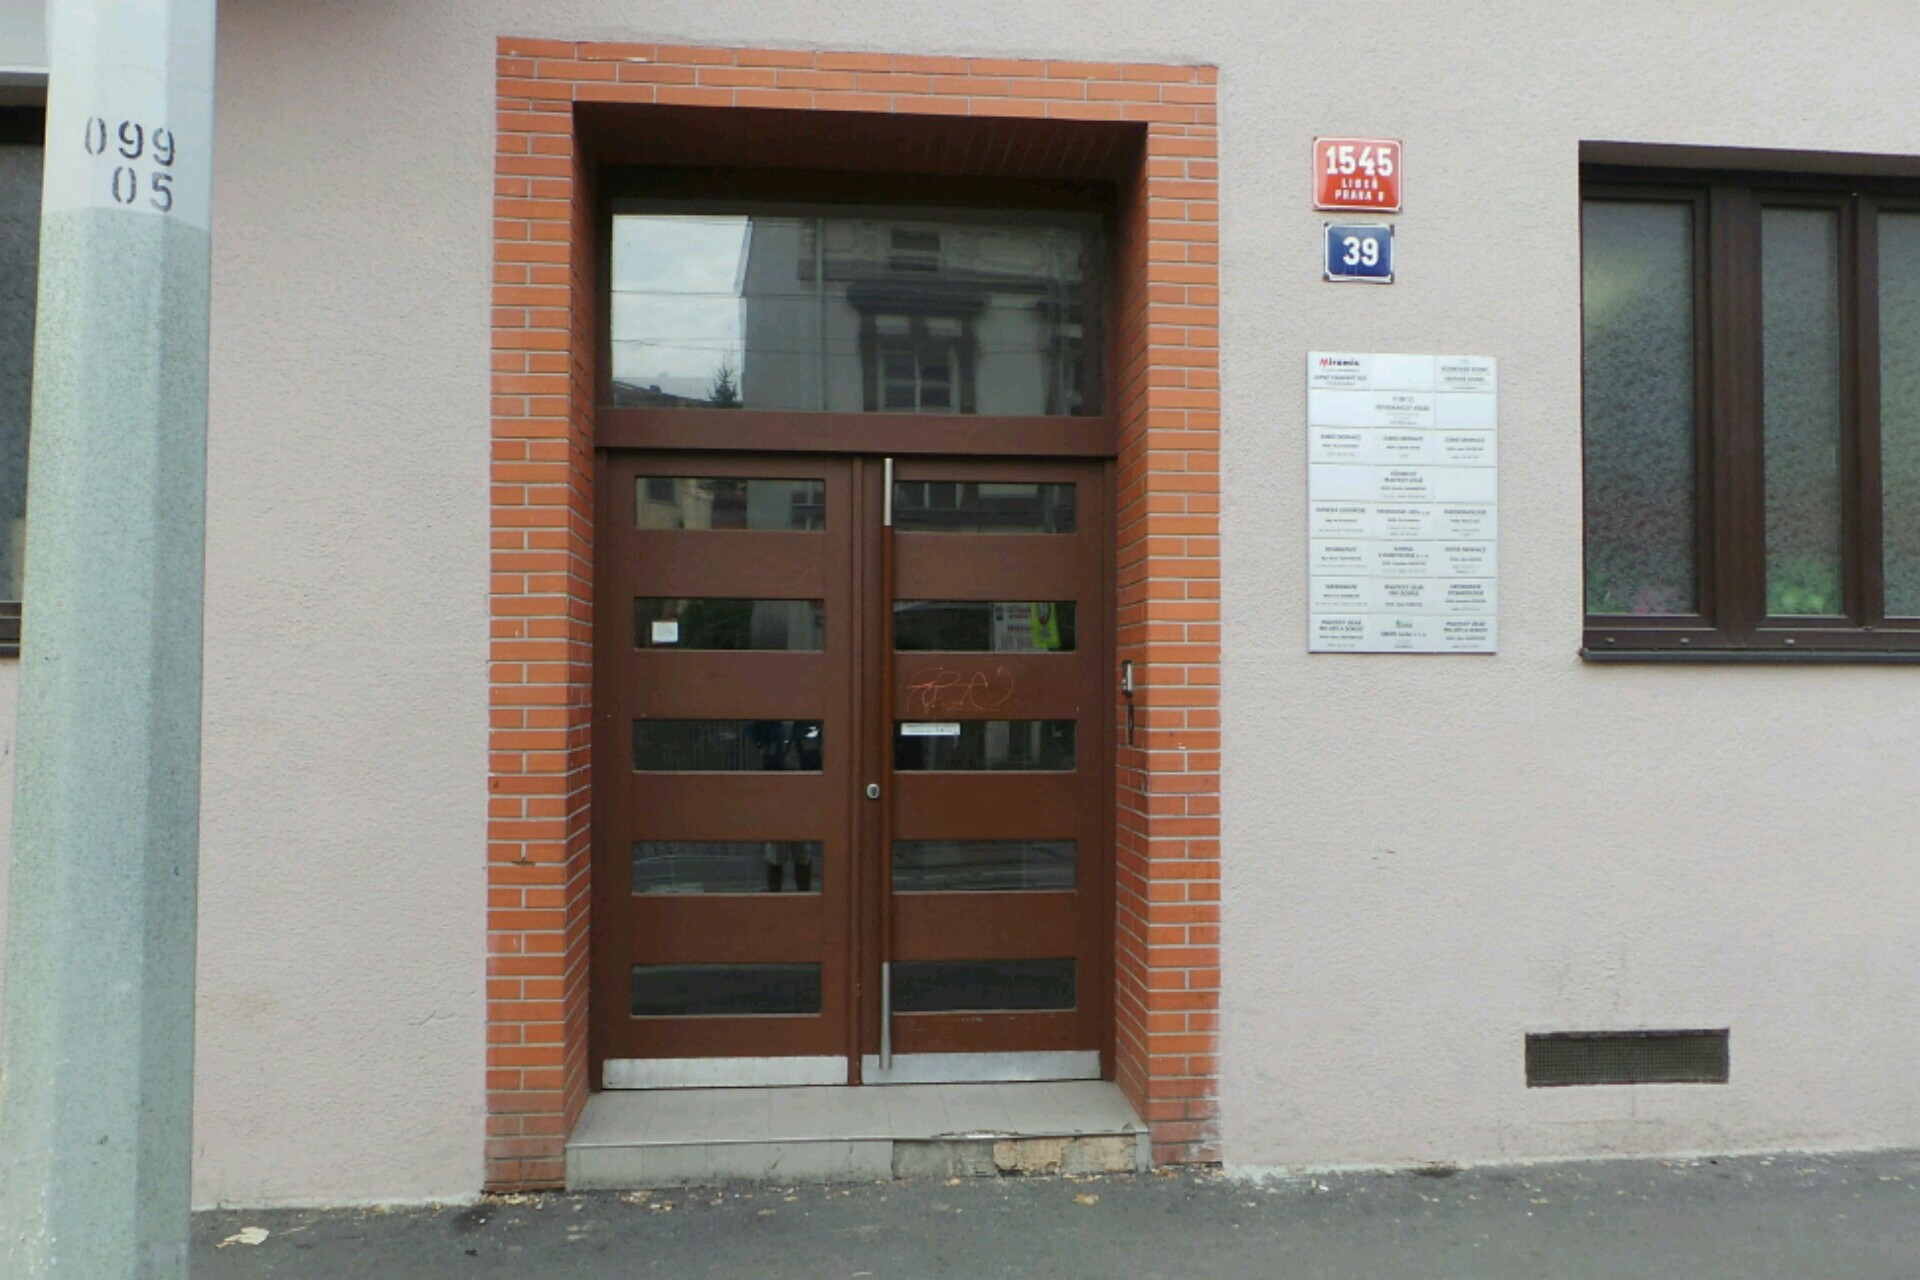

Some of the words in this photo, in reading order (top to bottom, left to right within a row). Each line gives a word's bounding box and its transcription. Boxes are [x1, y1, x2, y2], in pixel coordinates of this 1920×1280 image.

[84, 116, 175, 167] 099
[1326, 145, 1393, 176] 1545
[113, 167, 173, 212] 05
[1335, 189, 1372, 201] PRAHA
[1343, 236, 1379, 266] 39
